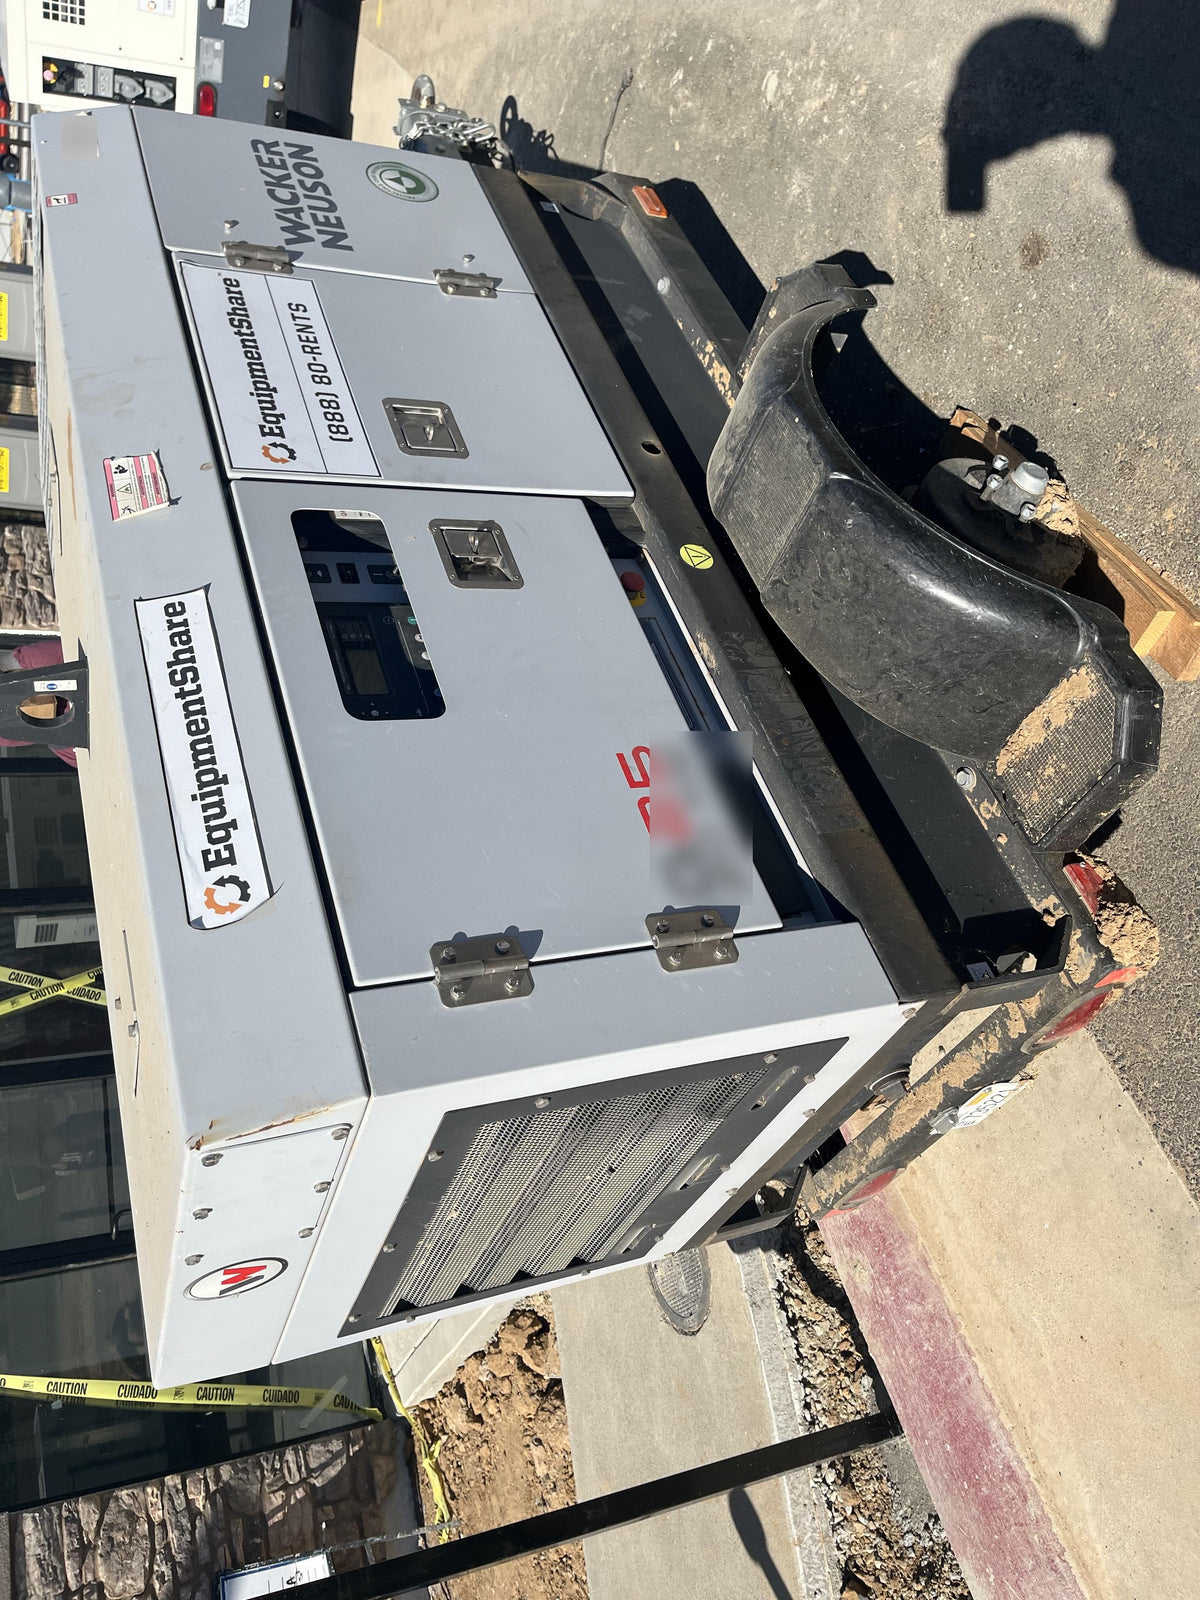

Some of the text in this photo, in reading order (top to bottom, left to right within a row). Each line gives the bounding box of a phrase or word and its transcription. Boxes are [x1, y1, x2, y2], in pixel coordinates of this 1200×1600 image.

[251, 139, 316, 246] WACKER
[283, 142, 354, 252] NEUSON
[222, 277, 286, 439] EquipmentShare
[288, 302, 354, 443] (888) 80-RENTS
[163, 600, 239, 873] EquipmentShare
[8, 971, 45, 988] CAUTION
[29, 981, 65, 1001] CAUTION
[46, 1381, 88, 1395] CAUTION
[117, 1384, 158, 1400] CUIDADO
[196, 1387, 235, 1401] CAUTION
[262, 1388, 300, 1404] CUIDADO
